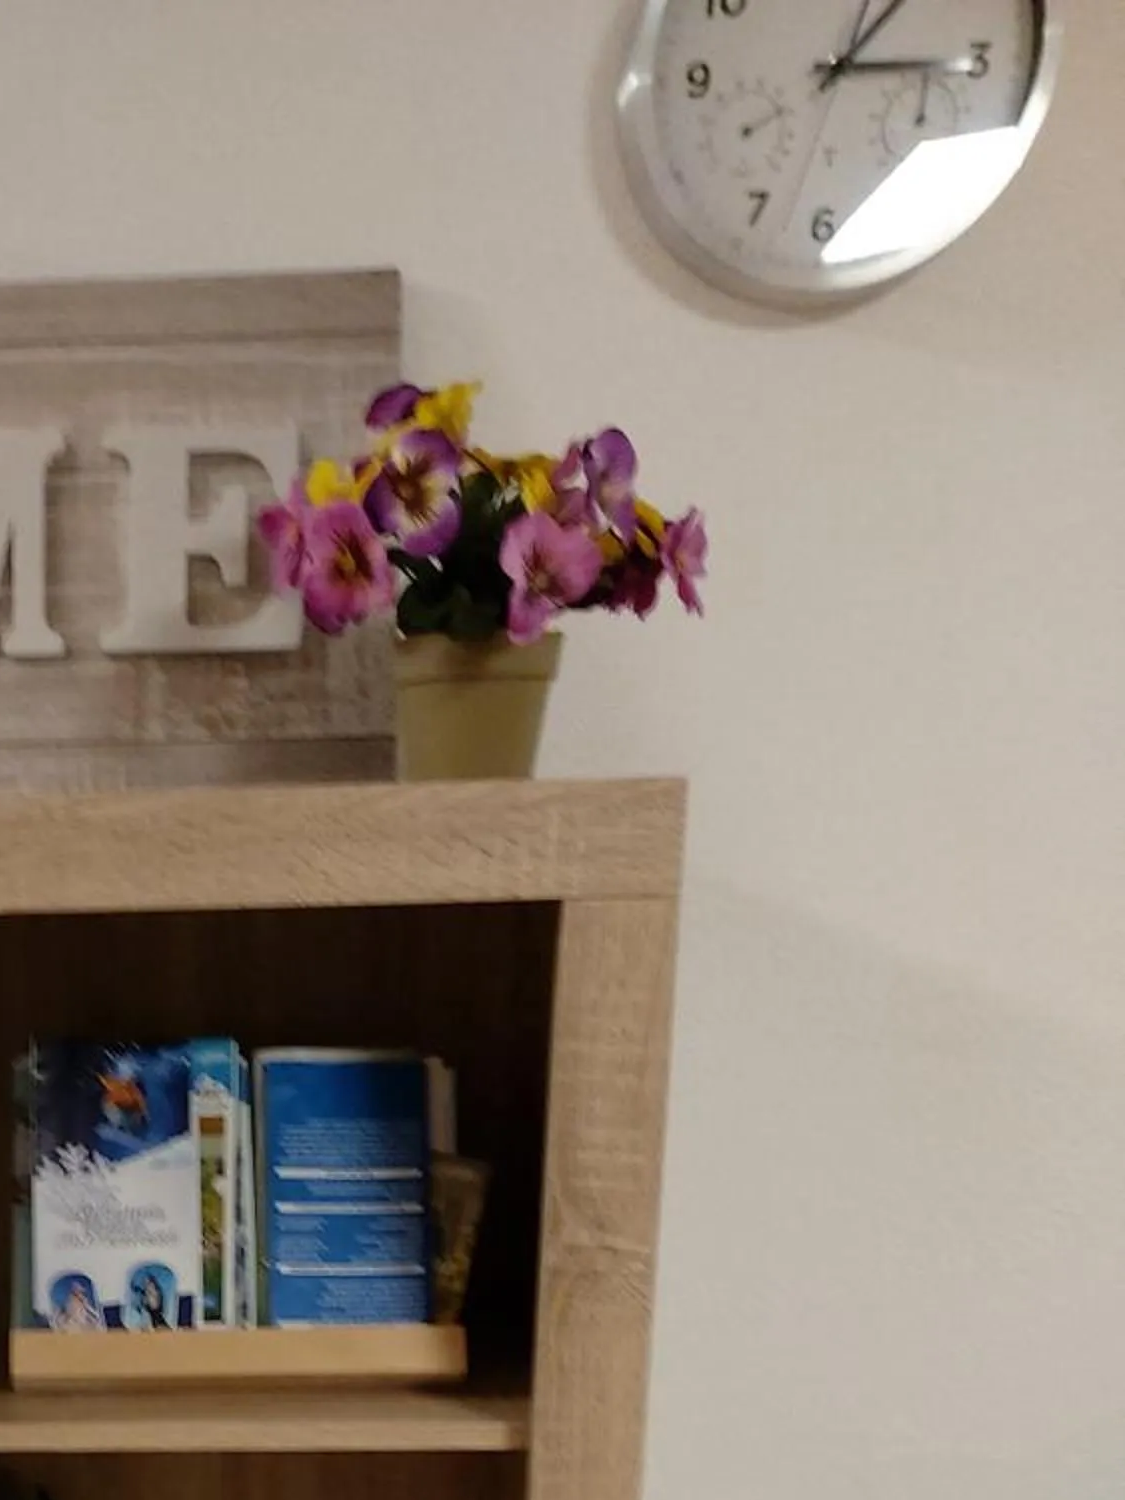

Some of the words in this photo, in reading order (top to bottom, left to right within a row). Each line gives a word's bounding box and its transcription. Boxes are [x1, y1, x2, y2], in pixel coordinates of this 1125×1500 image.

[968, 41, 993, 79] 3
[685, 62, 712, 99] 9
[748, 190, 770, 227] 7
[811, 208, 835, 243] 6
